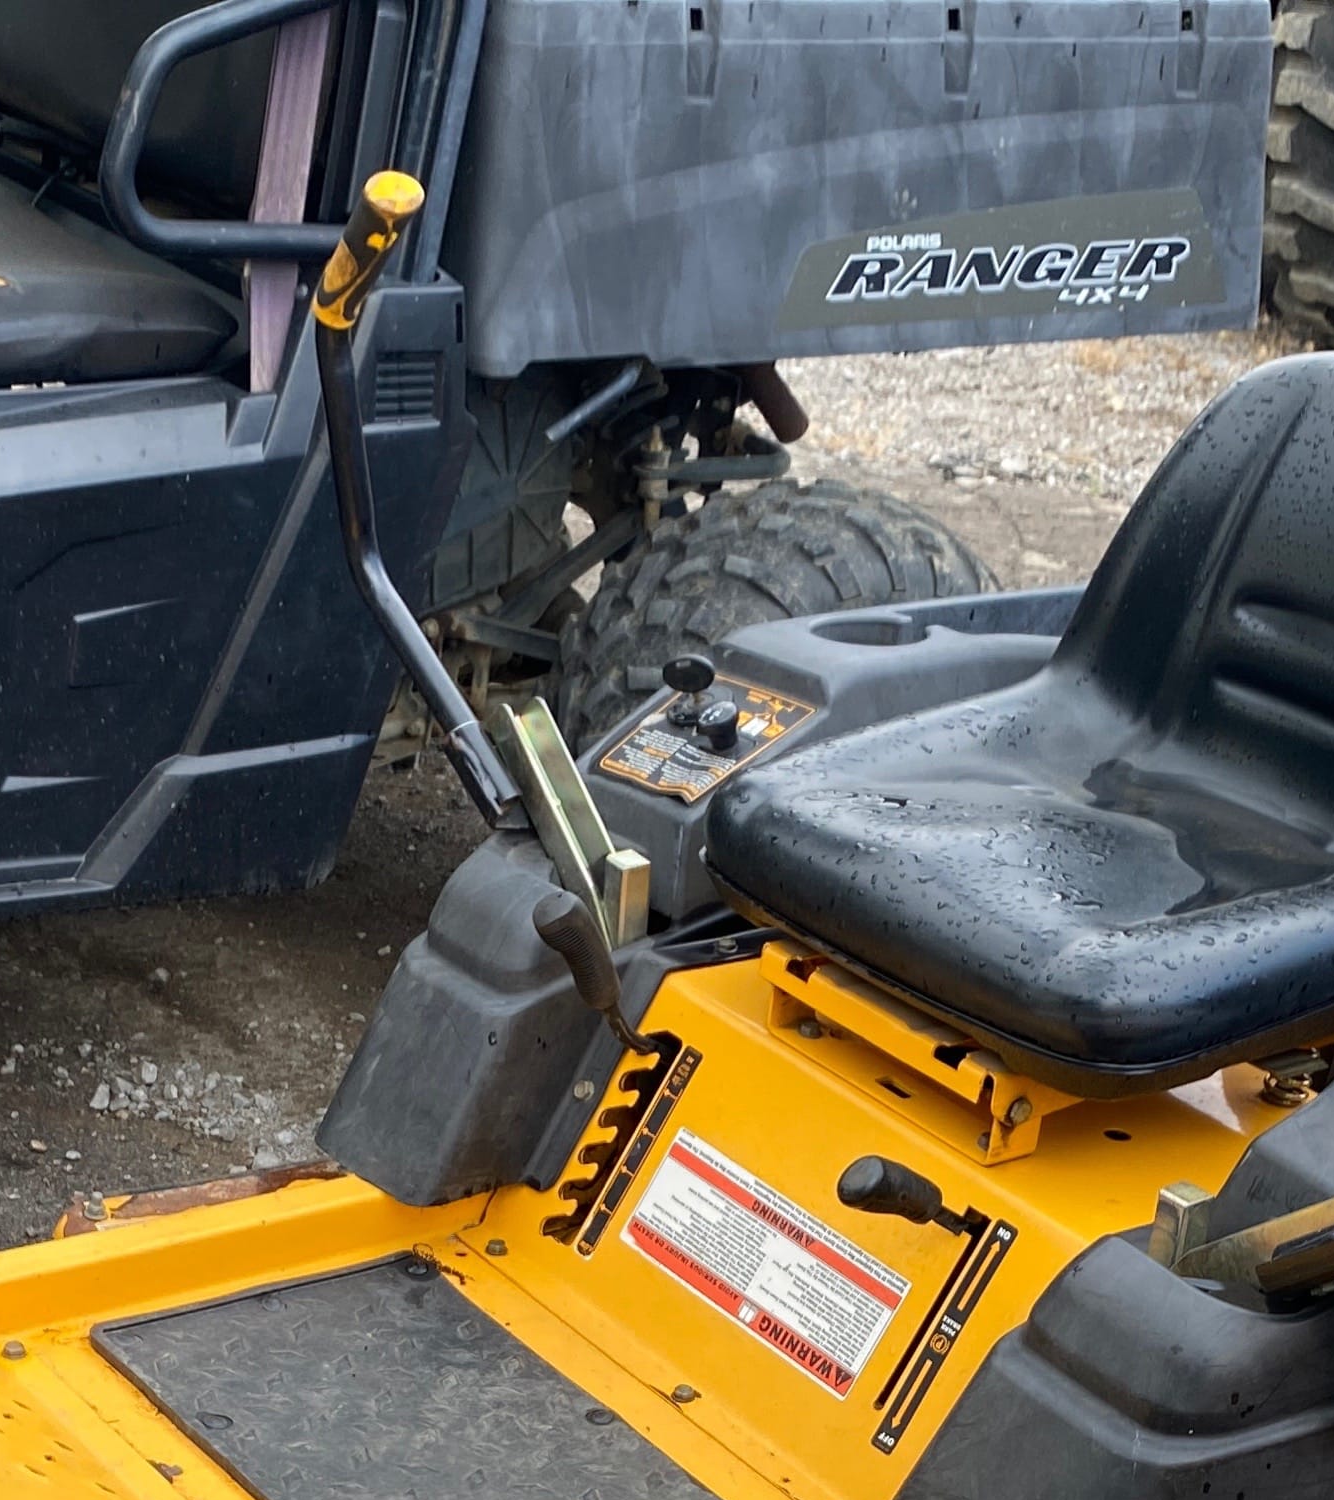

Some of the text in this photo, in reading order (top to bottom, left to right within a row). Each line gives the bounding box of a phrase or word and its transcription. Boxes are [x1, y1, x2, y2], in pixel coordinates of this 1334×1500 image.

[867, 232, 943, 252] POLARIS
[825, 237, 1191, 302] RANGER
[751, 1199, 805, 1242] WARNING
[996, 1226, 1012, 1241] ON
[756, 1314, 833, 1379] WARNING
[877, 1431, 895, 1447] OFF
